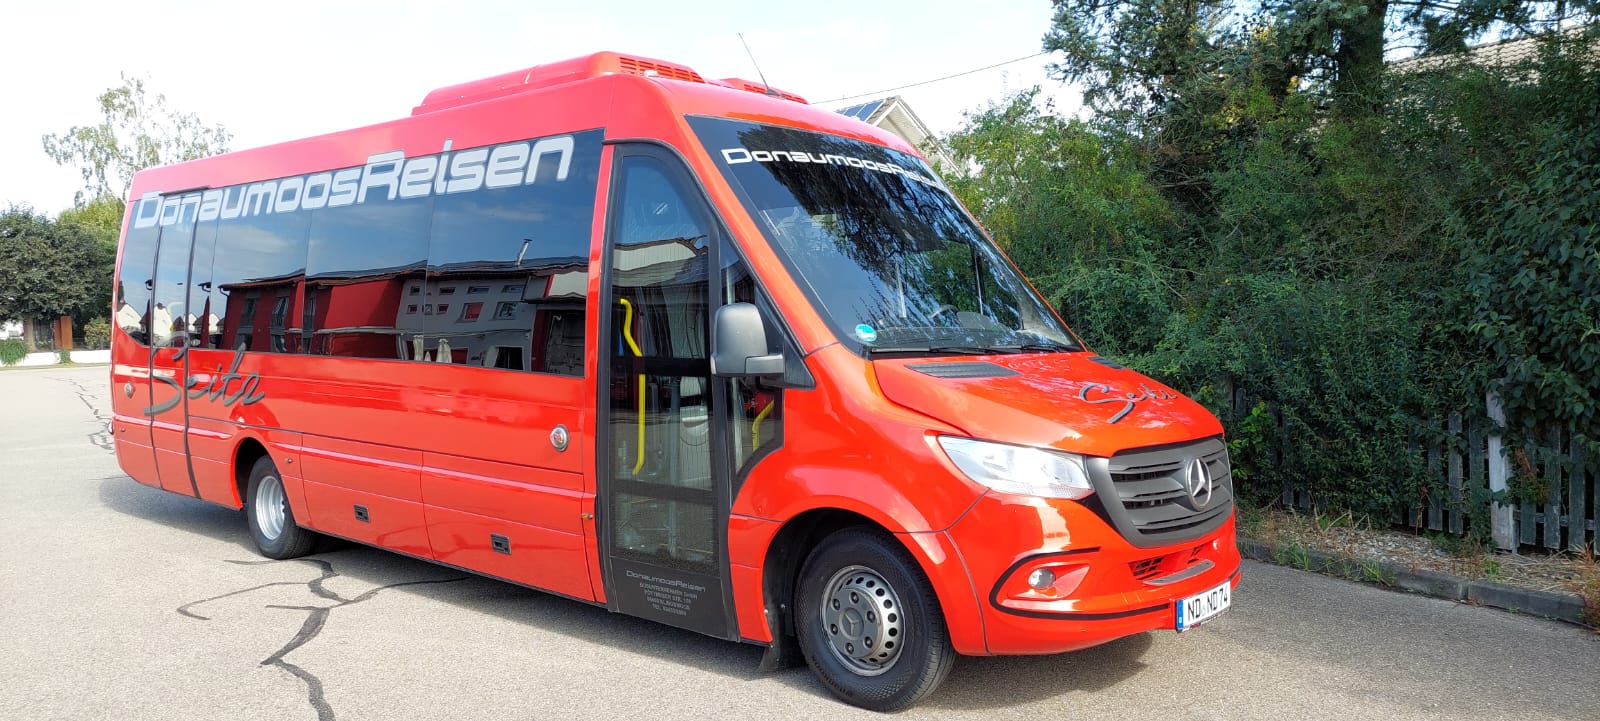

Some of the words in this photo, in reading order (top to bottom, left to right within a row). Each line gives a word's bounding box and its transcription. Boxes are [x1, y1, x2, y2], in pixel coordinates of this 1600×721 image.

[134, 135, 575, 229] DonaumoosReisen
[626, 570, 706, 592] DonaumoosReisen
[1188, 598, 1201, 622] ND
[1207, 591, 1218, 613] ND
[1219, 584, 1228, 607] 74
